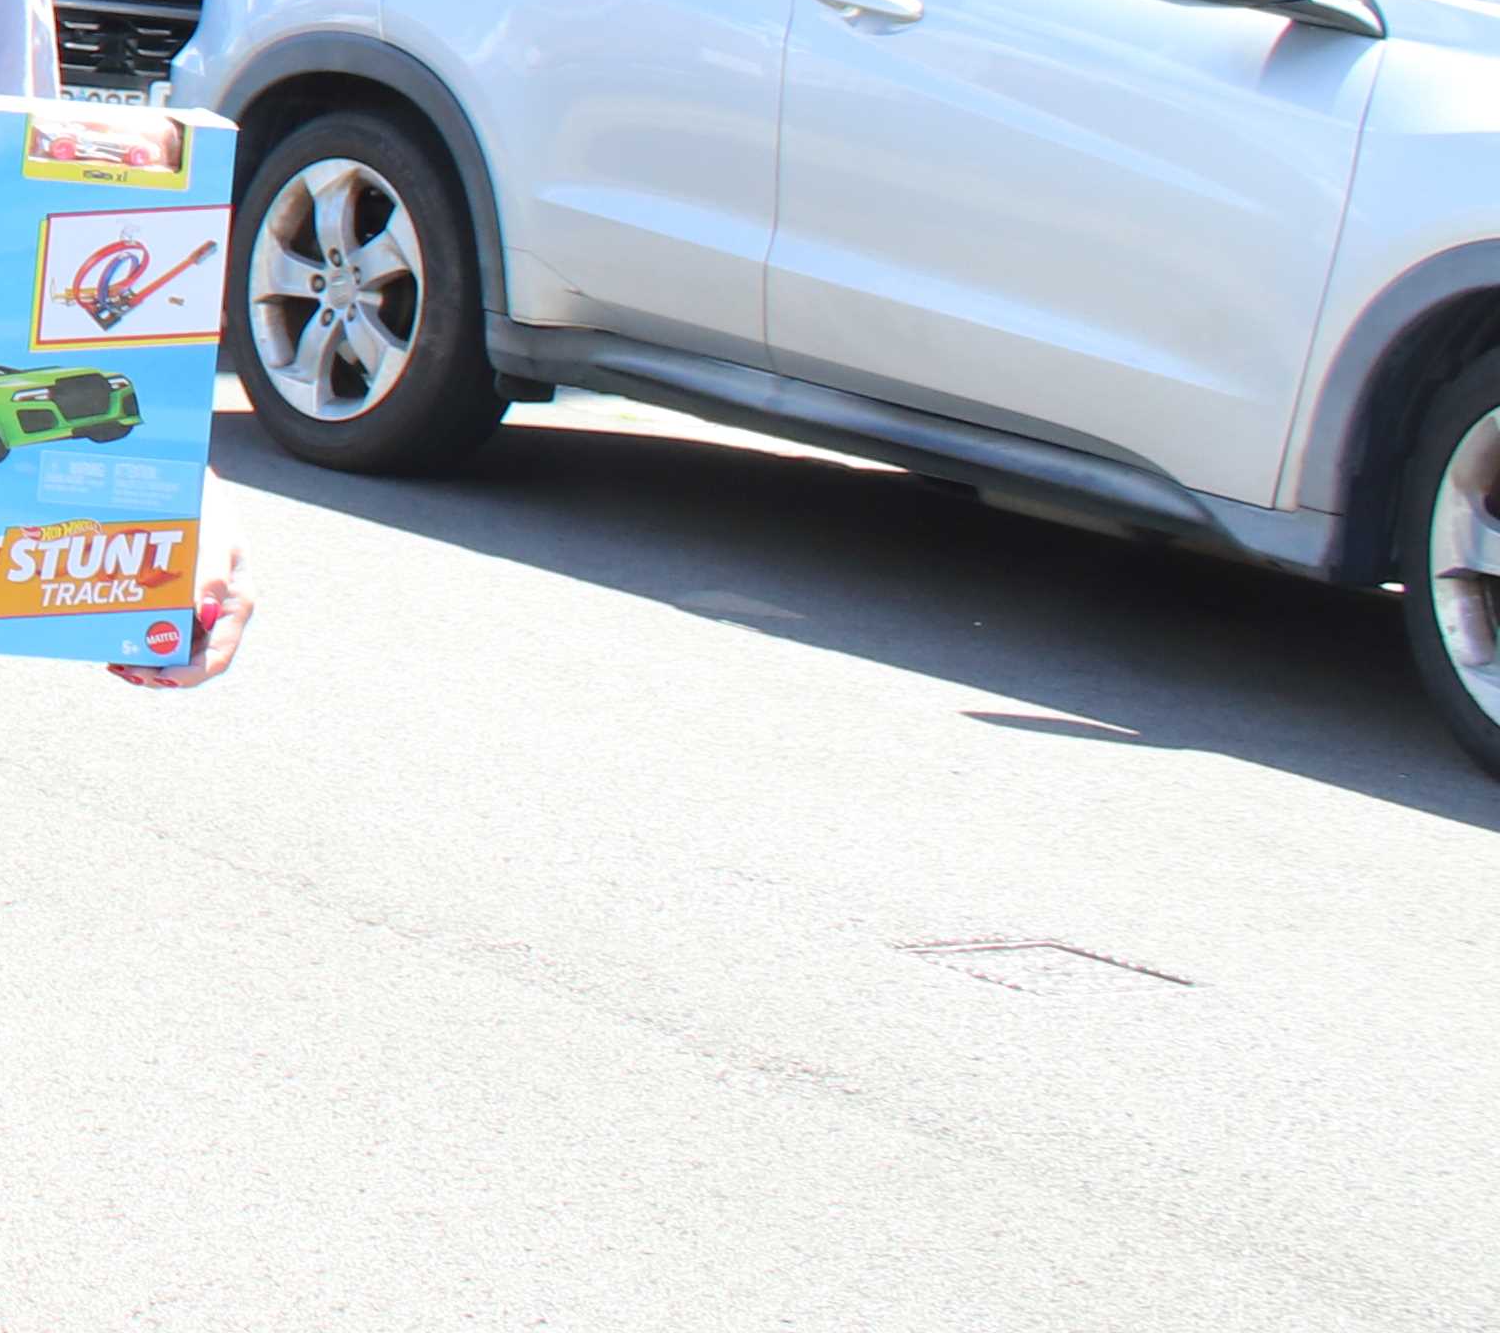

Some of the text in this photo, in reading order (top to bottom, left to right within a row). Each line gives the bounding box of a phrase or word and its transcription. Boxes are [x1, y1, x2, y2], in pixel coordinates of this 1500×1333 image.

[6, 530, 184, 583] STUNT
[41, 580, 144, 607] TRACKS
[146, 631, 180, 645] MATTEL
